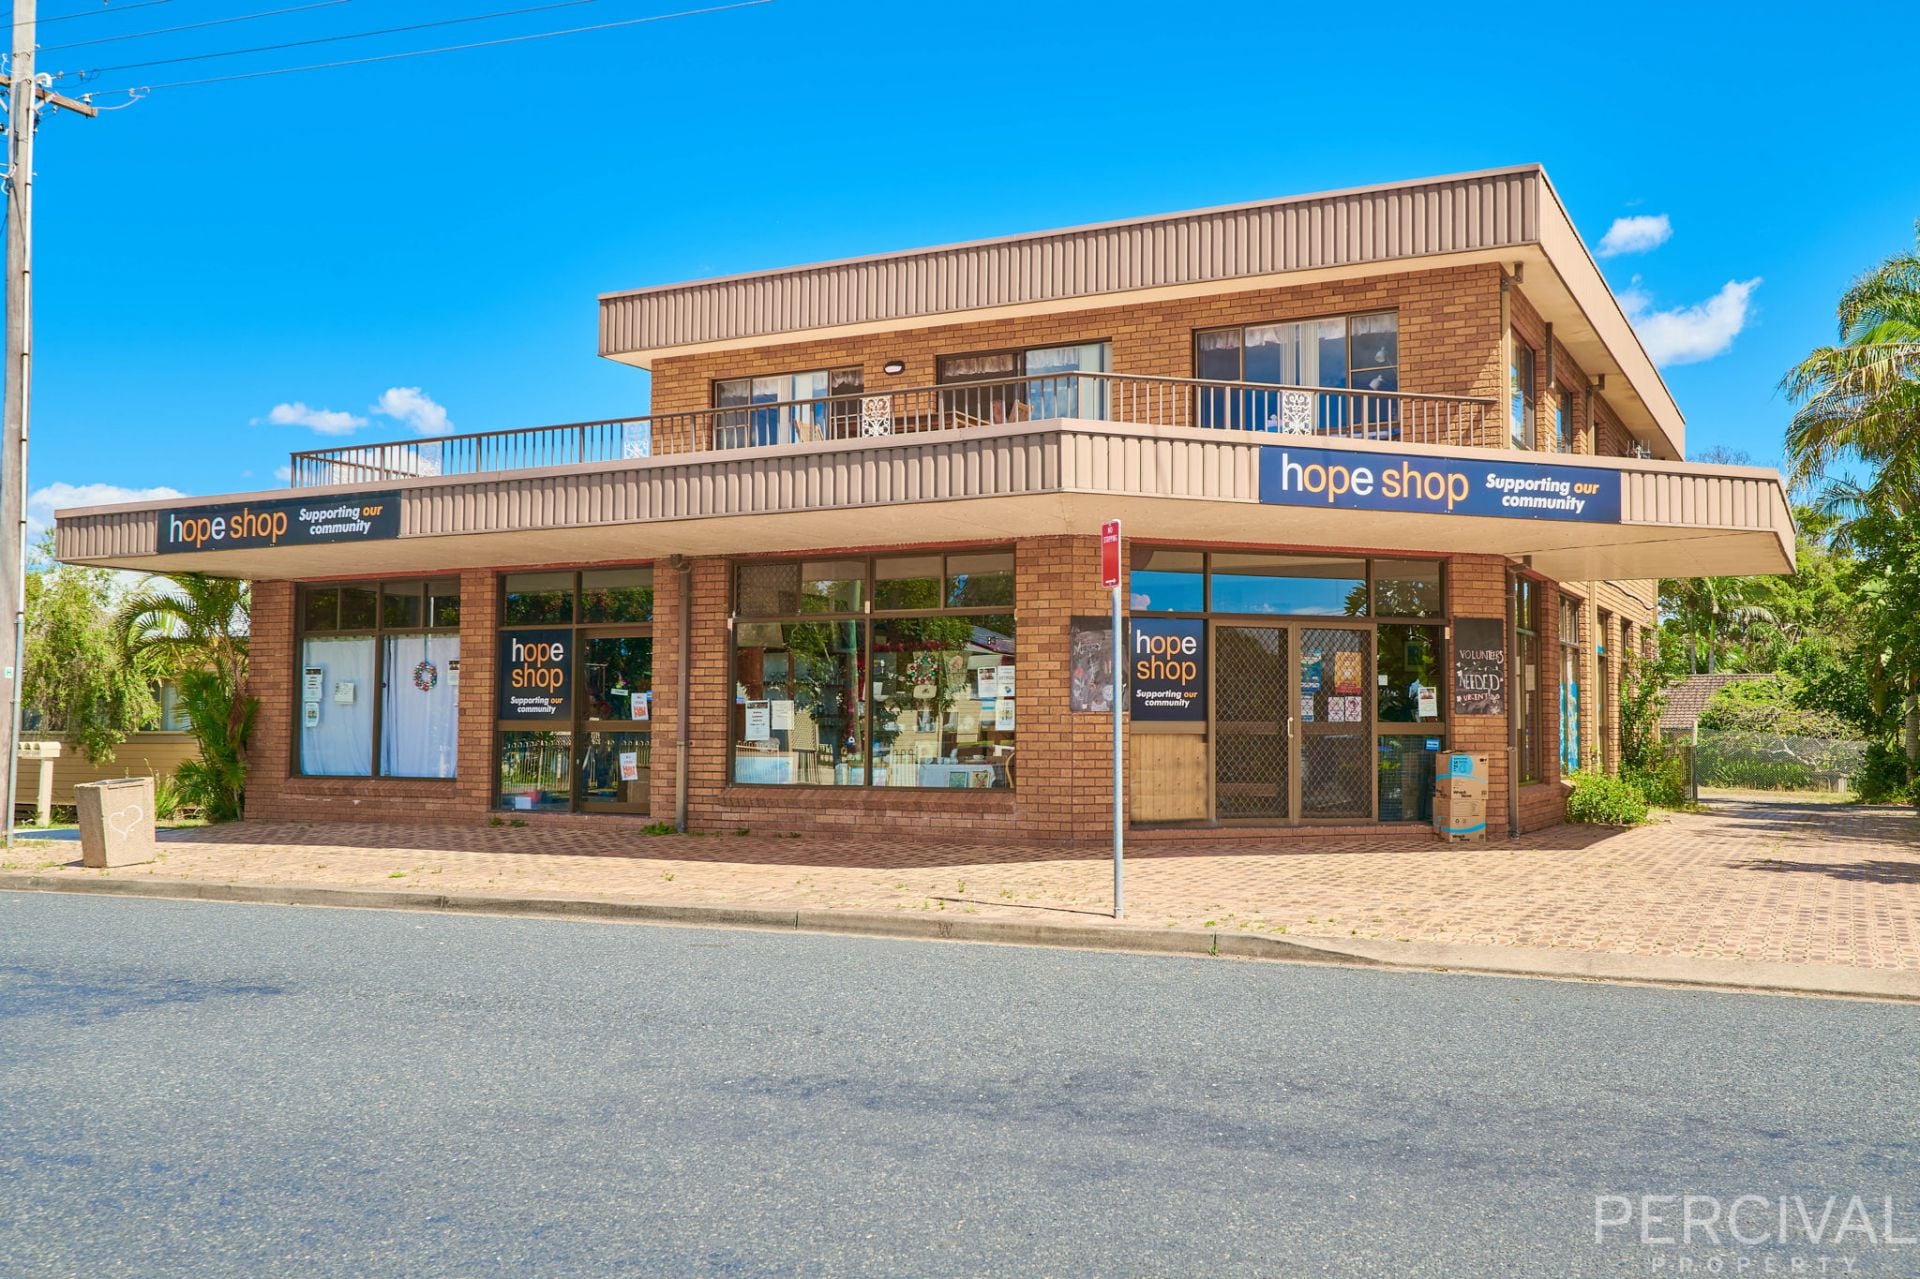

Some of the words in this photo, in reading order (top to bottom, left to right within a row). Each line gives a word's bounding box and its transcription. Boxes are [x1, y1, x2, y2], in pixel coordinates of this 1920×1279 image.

[1281, 452, 1374, 503] hope
[1381, 461, 1469, 510] shop
[1485, 473, 1571, 496] Supporting
[1573, 481, 1600, 495] our
[299, 505, 360, 521] Supporting
[362, 504, 383, 518] our
[1501, 493, 1586, 515] community
[169, 513, 226, 548] hope
[229, 507, 288, 544] shop
[309, 518, 372, 536] community
[511, 637, 564, 668] hope
[1136, 629, 1197, 660] hope
[1459, 649, 1504, 664] VOLUNTEERS
[511, 662, 564, 693] shop
[1136, 655, 1197, 686] shop
[1458, 673, 1500, 691] NEEDED
[510, 695, 550, 706] Supporting
[1136, 689, 1182, 700] Supporting
[1144, 699, 1190, 709] community
[517, 704, 556, 715] community
